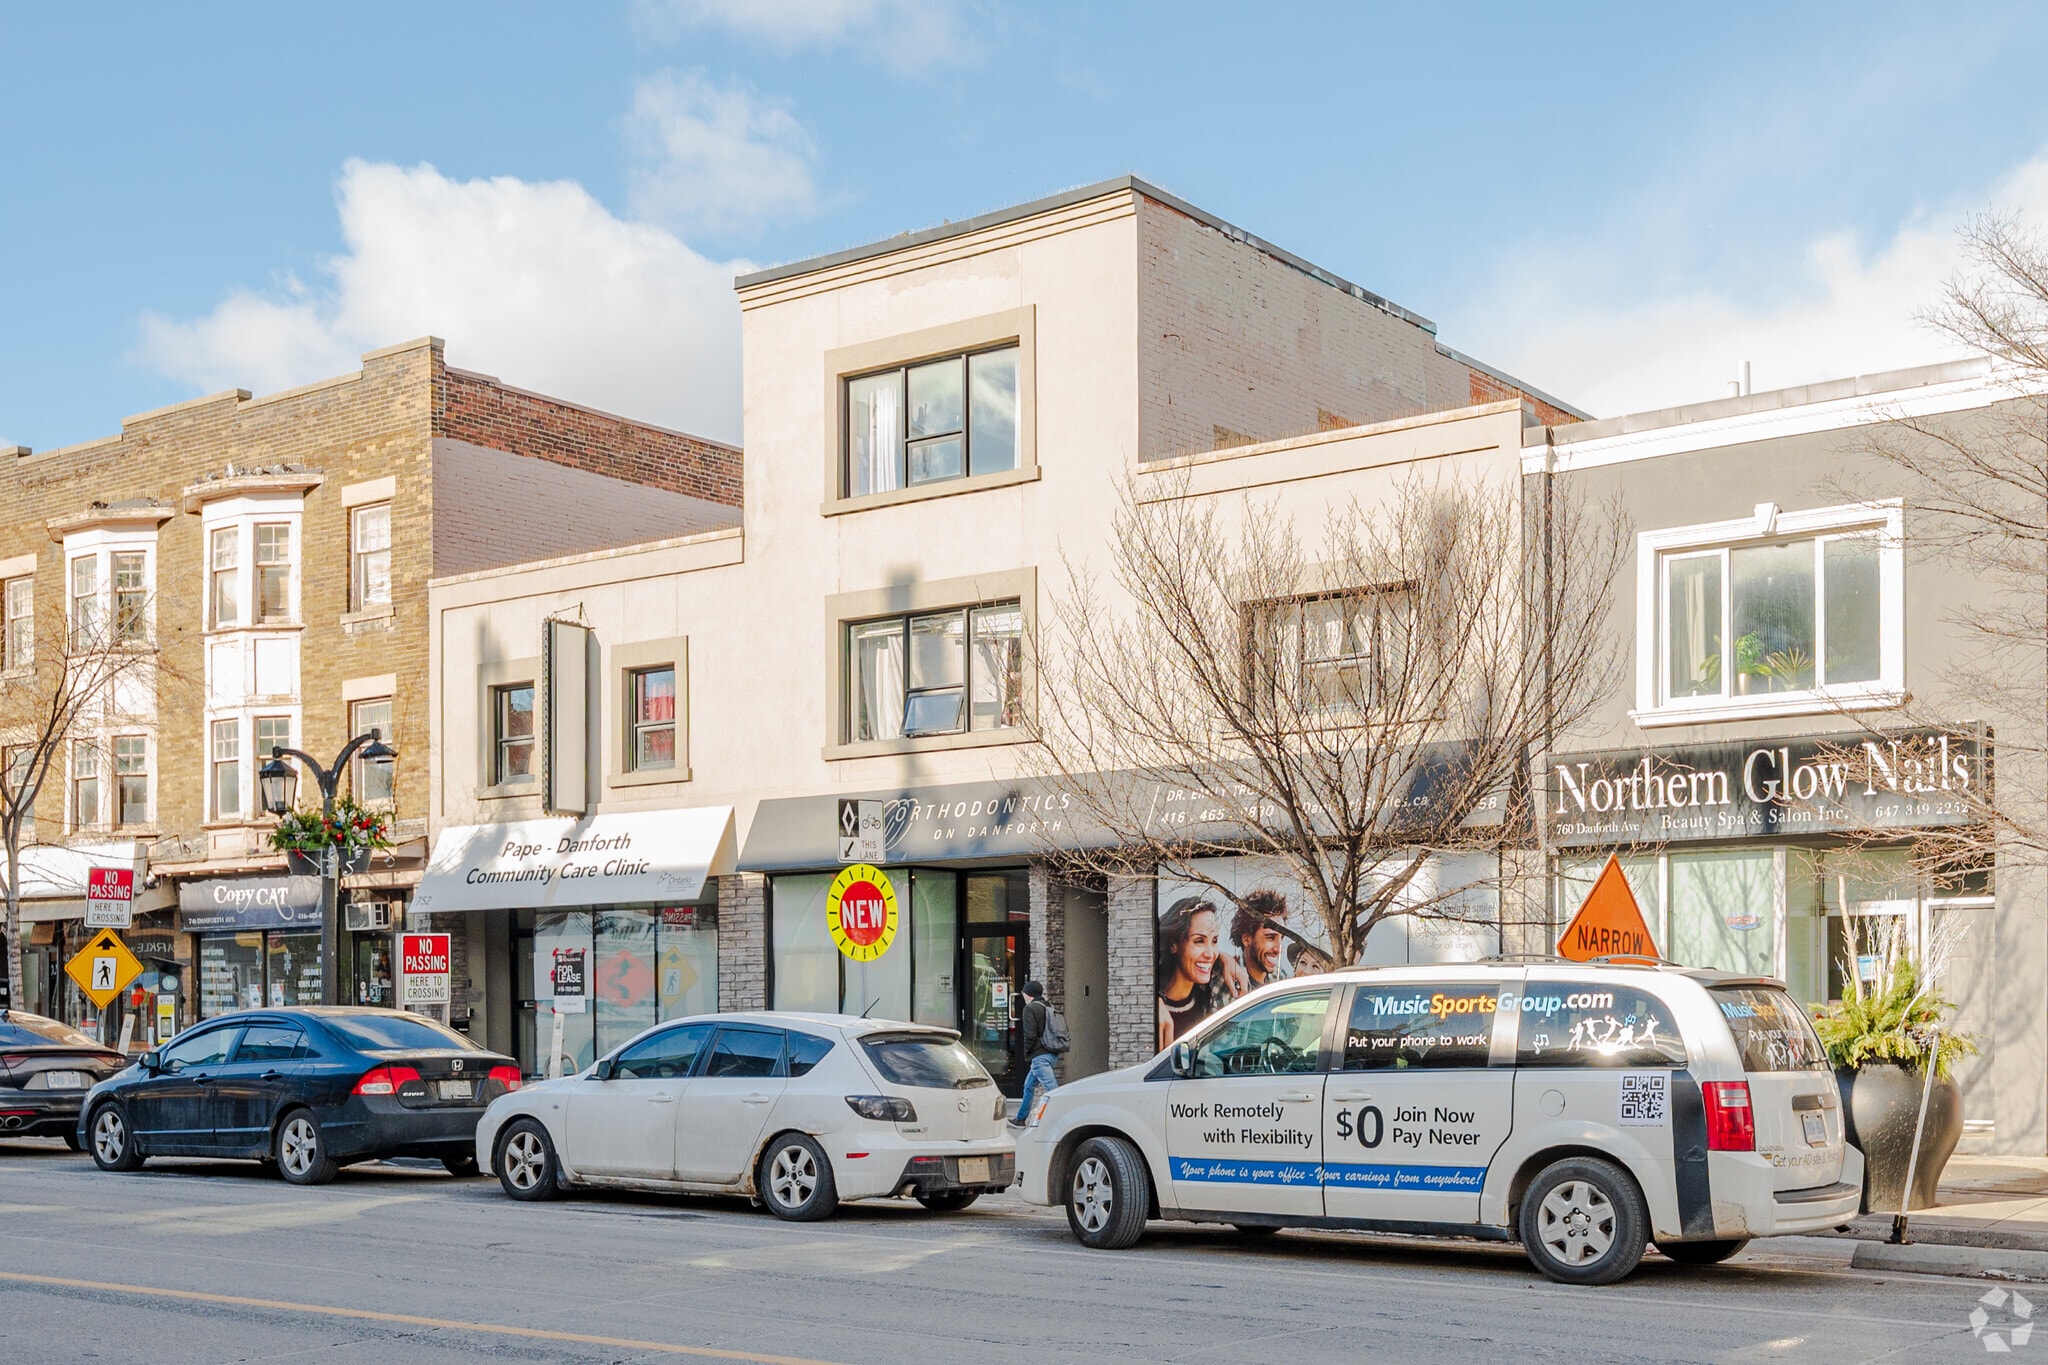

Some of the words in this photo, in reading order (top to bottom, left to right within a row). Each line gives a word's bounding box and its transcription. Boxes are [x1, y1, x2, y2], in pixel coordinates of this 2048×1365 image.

[1555, 754, 1731, 814] Northern
[1743, 747, 1850, 804] Glow
[1862, 736, 1970, 796] Nails
[1167, 789, 1186, 801] DR.
[895, 793, 1071, 822] ORTHODONTICS
[1160, 811, 1186, 823] 416
[1200, 808, 1225, 820] 465
[1875, 805, 1899, 818] 647
[1661, 814, 1711, 830] Beauty
[1717, 811, 1745, 830] Spa
[1750, 810, 1763, 824] &
[1768, 807, 1812, 824] Salon
[1818, 805, 1849, 821] Inc.
[933, 828, 955, 840] ON
[967, 820, 1062, 838] DANFORTH
[1556, 823, 1574, 835] 760
[1576, 821, 1619, 834] Danforth
[1621, 821, 1640, 833] Ave
[501, 841, 542, 861] Pape
[556, 832, 632, 854] Danforth
[861, 840, 877, 850] THIS
[860, 850, 879, 860] LANE
[104, 870, 118, 885] NO
[466, 864, 556, 885] Community
[560, 863, 598, 879] Care
[603, 858, 650, 877] Clinic
[90, 884, 131, 899] PASSING
[94, 902, 112, 912] HERE
[116, 903, 124, 913] TO
[213, 885, 256, 914] Copy
[255, 886, 294, 920] CAT
[92, 913, 125, 923] CROSSING
[841, 899, 884, 930] NEW
[419, 938, 433, 954] NO
[1578, 925, 1644, 955] NARROW
[405, 955, 447, 971] PASSING
[557, 965, 573, 975] FOR
[410, 976, 430, 987] HERE
[433, 975, 443, 987] TO
[557, 973, 582, 983] LEASE
[407, 987, 445, 999] CROSSING
[1373, 992, 1614, 1019] MusicSportsGroup.com
[1348, 1035, 1368, 1048] Put
[1371, 1036, 1397, 1049] your
[1400, 1035, 1435, 1048] phone
[1440, 1035, 1452, 1046] to
[1457, 1034, 1487, 1046] work
[1748, 1029, 1766, 1041] Put
[1766, 1029, 1783, 1041] your
[1171, 1103, 1208, 1118] Work
[1214, 1102, 1284, 1122] Remotely
[1393, 1106, 1427, 1123] Join
[1434, 1107, 1475, 1123] Now
[1336, 1105, 1384, 1149] $0
[1203, 1128, 1235, 1143] with
[1241, 1129, 1313, 1149] Flexibility
[1393, 1128, 1422, 1148] Pay
[1429, 1129, 1480, 1145] Never
[1773, 1155, 1786, 1168] Get
[1788, 1156, 1802, 1170] your
[1180, 1161, 1205, 1179] Your
[1208, 1162, 1236, 1179] phone
[1239, 1167, 1249, 1177] is
[1252, 1169, 1275, 1181] your
[1278, 1166, 1306, 1183] office
[1345, 1171, 1391, 1186] earnings
[1393, 1170, 1420, 1187] from
[1424, 1171, 1484, 1188] anywhere!
